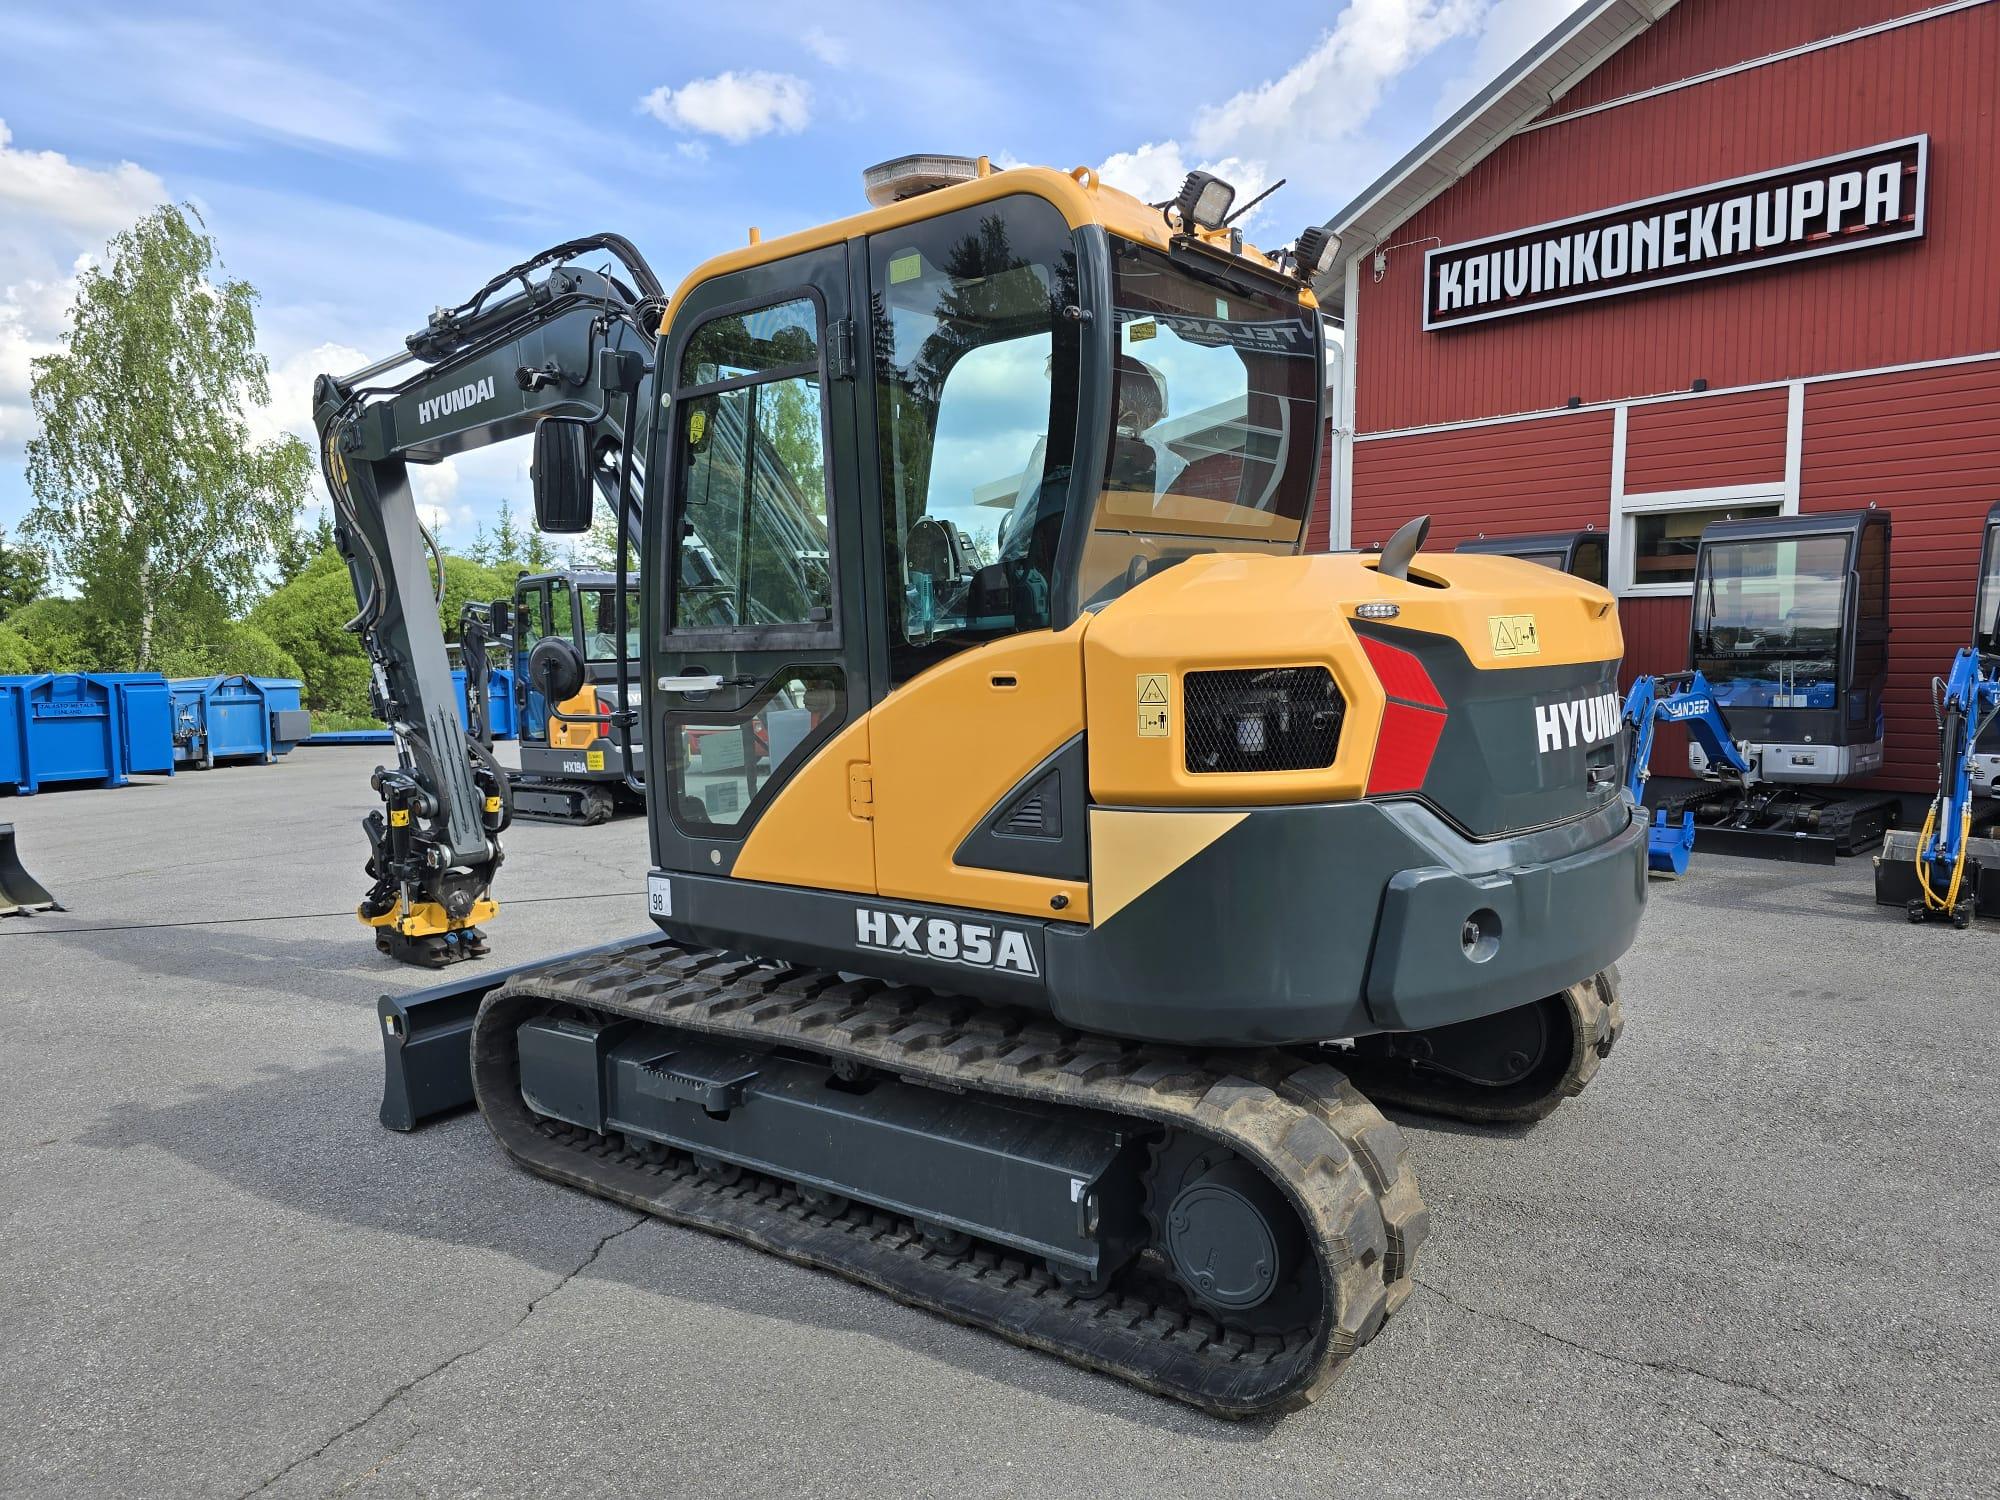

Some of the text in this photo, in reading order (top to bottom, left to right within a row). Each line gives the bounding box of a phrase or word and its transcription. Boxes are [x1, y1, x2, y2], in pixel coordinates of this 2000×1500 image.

[1439, 161, 1902, 311] KAIVINKONEKAUPPA
[418, 376, 495, 424] HYUNDAI
[1535, 691, 1622, 753] HYUNDA
[563, 761, 587, 773] HX19A
[653, 893, 663, 911] 98
[856, 909, 1037, 975] HX85A
